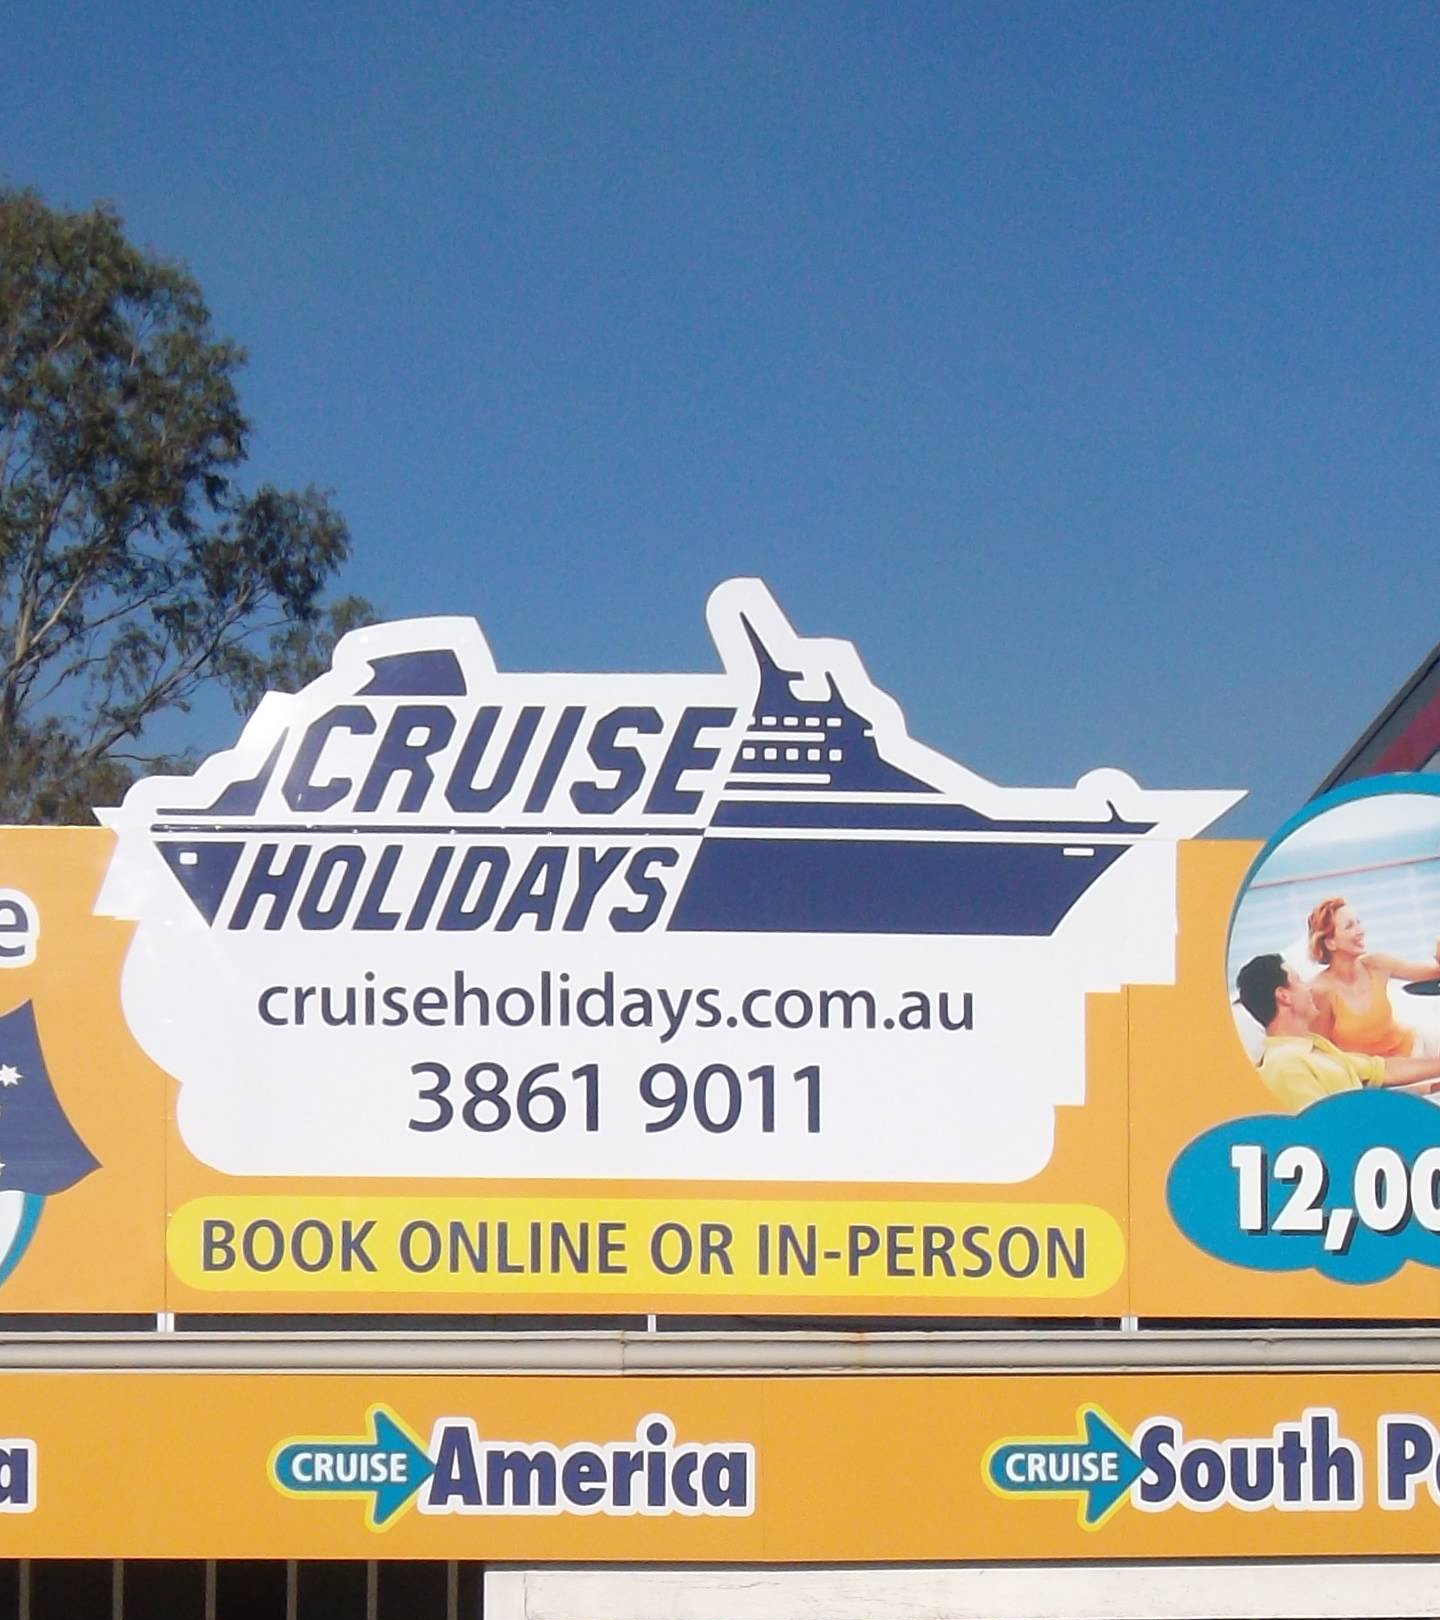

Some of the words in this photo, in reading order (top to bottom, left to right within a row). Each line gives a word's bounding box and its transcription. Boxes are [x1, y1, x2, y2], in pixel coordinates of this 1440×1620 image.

[282, 705, 737, 814] CRUISE
[229, 845, 681, 932] HOLIDAYS
[258, 971, 974, 1042] cruiseholidays.com.au
[408, 1061, 602, 1134] 3861
[638, 1064, 823, 1134] 9011
[201, 1218, 377, 1273] BOOK
[398, 1220, 627, 1275] ONLINE
[650, 1222, 734, 1276] OR
[758, 1224, 1087, 1279] IN-PERSON
[291, 1452, 408, 1483] CRUISE
[429, 1423, 748, 1508] America
[1005, 1452, 1119, 1484] CRUISE
[1141, 1416, 1356, 1504] South
